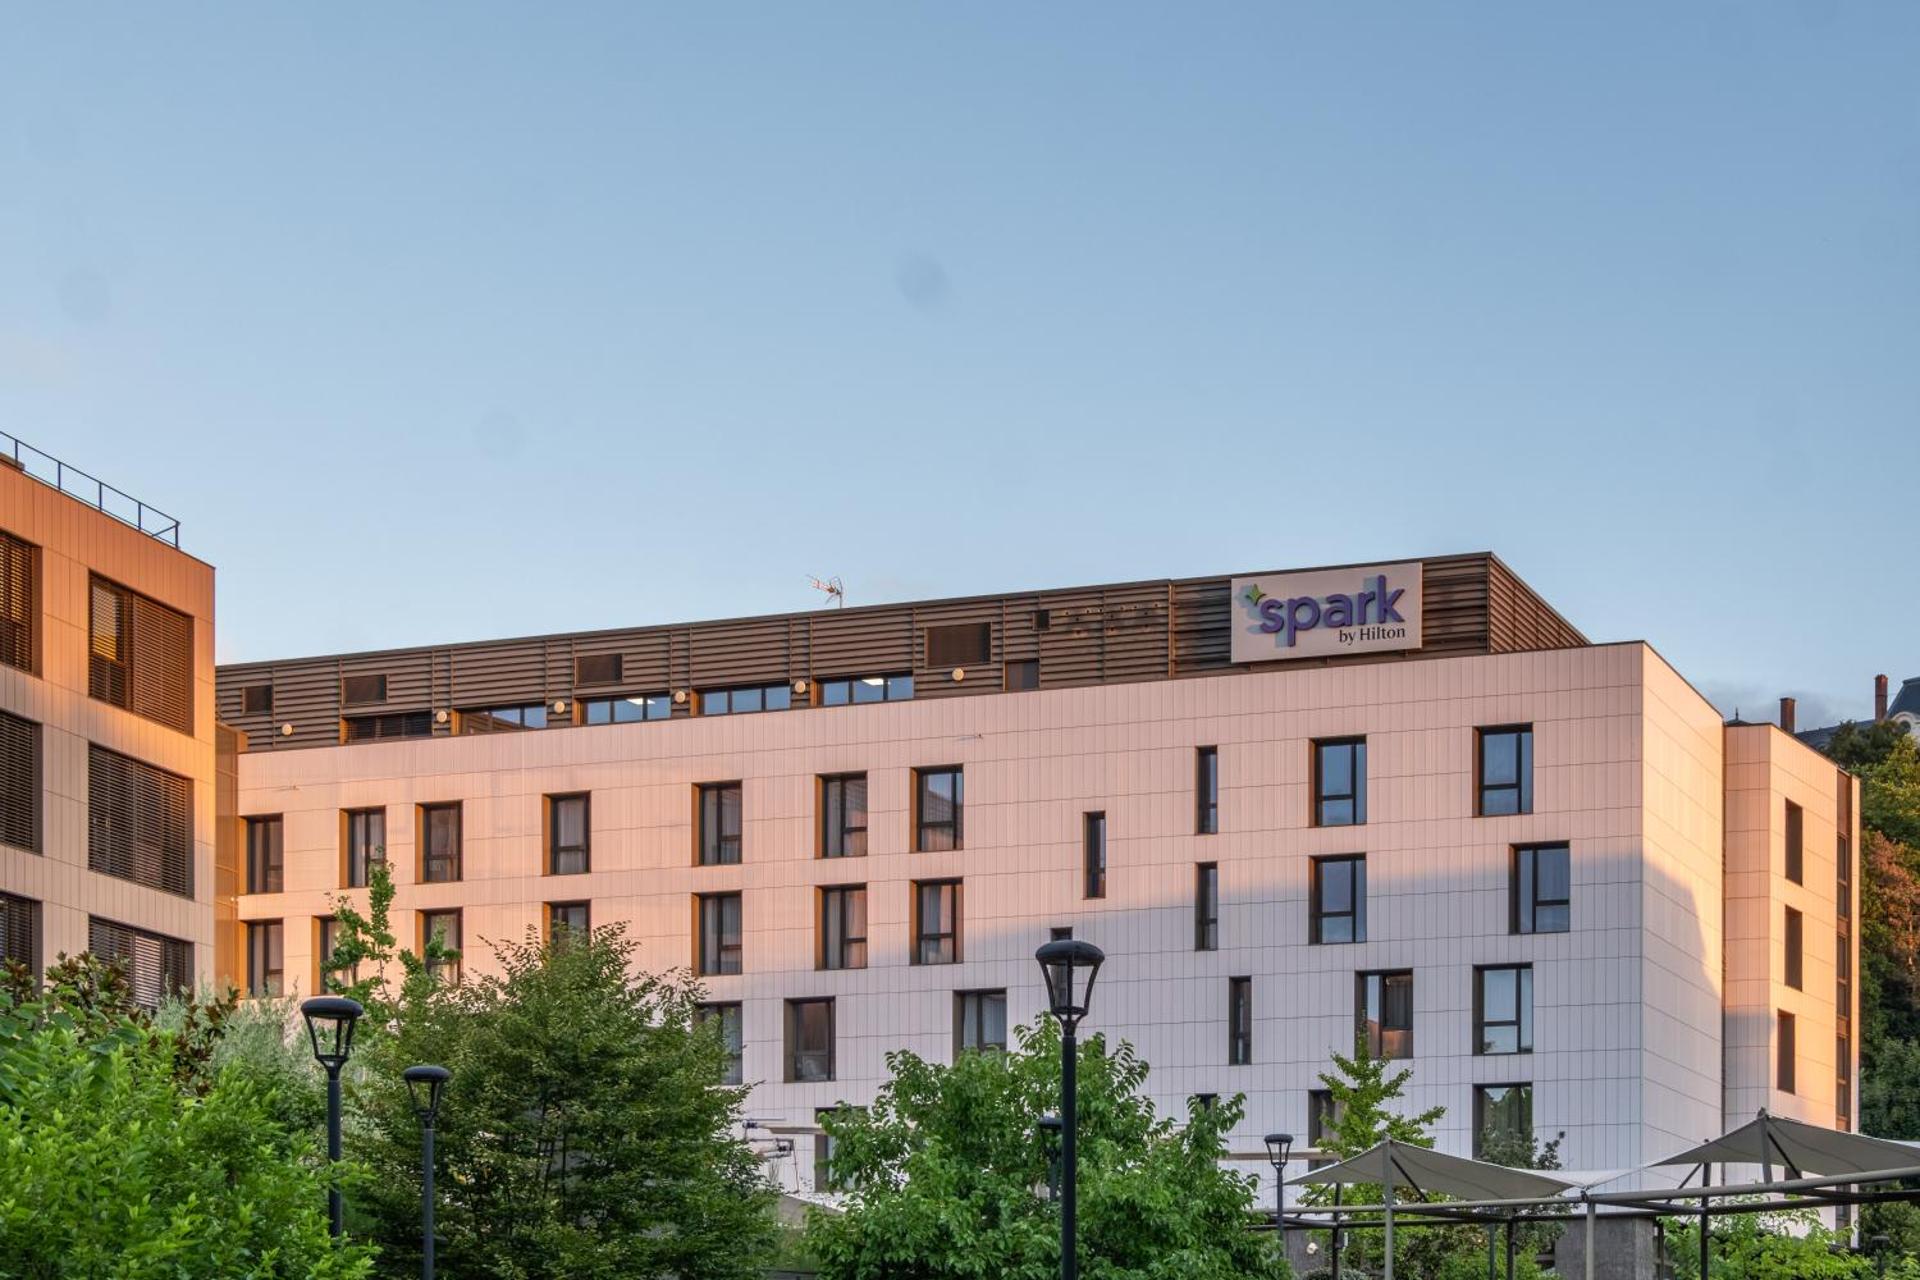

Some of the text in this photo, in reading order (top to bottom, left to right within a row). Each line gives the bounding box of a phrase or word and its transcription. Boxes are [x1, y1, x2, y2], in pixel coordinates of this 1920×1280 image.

[1259, 574, 1406, 648] spark
[1339, 626, 1406, 646] by Hilton
